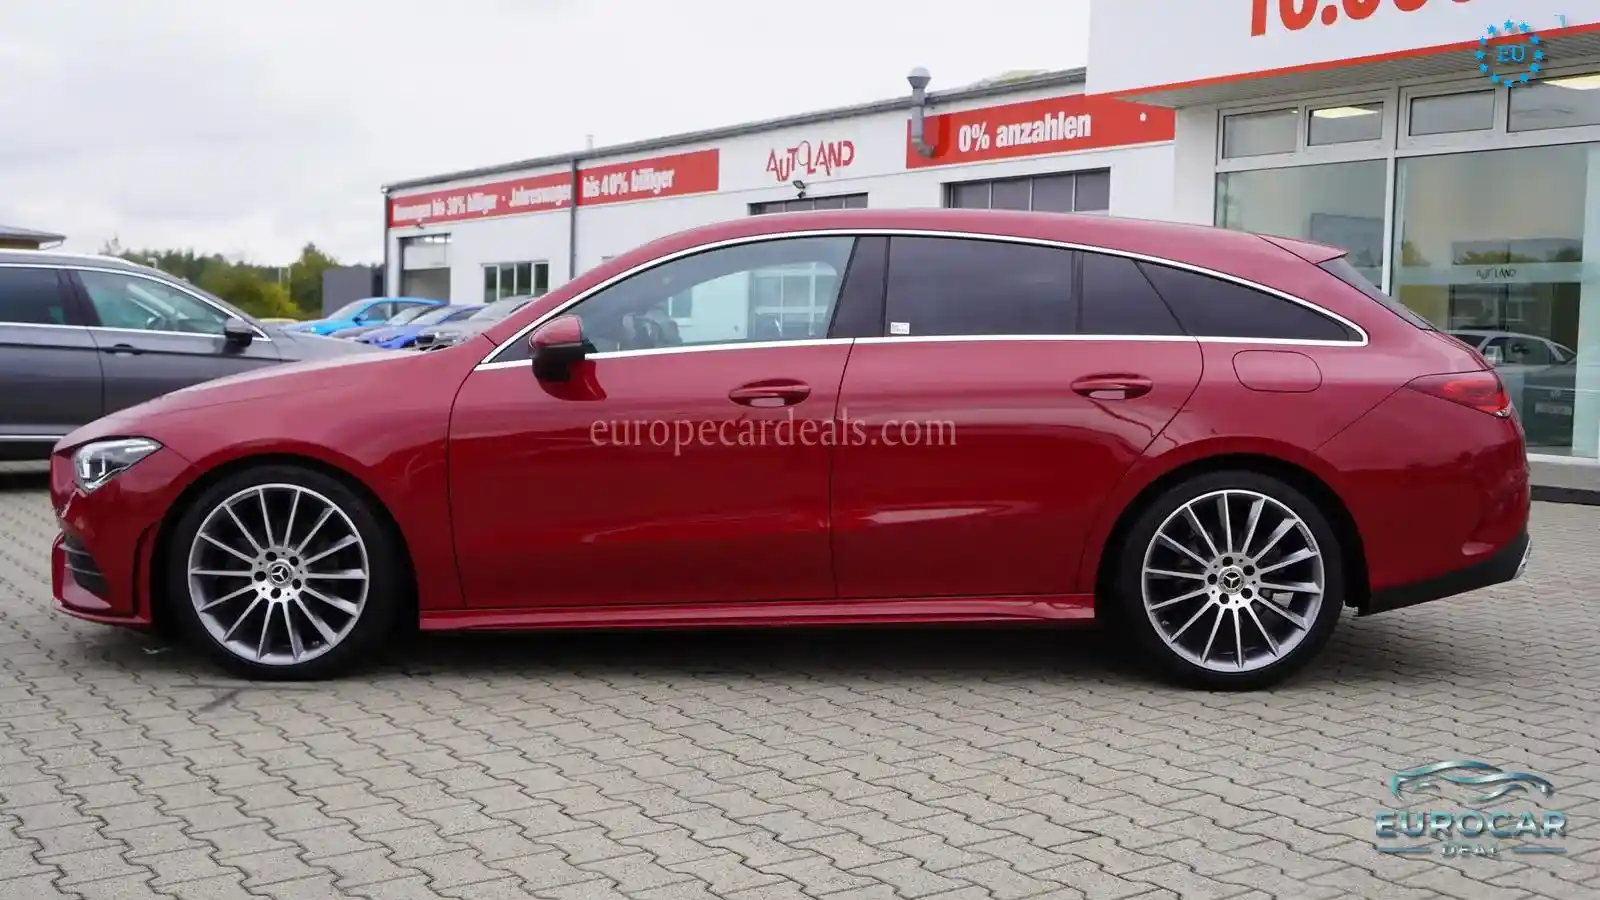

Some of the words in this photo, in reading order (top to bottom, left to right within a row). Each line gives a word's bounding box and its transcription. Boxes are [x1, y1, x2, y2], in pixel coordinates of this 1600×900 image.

[958, 123, 990, 154] 0%
[995, 111, 1092, 149] anzahlen
[766, 140, 855, 182] AUTOLAND
[582, 176, 600, 198] bis
[600, 171, 629, 196] 40%
[631, 168, 675, 194] billiger
[1476, 267, 1516, 279] AUTLAND
